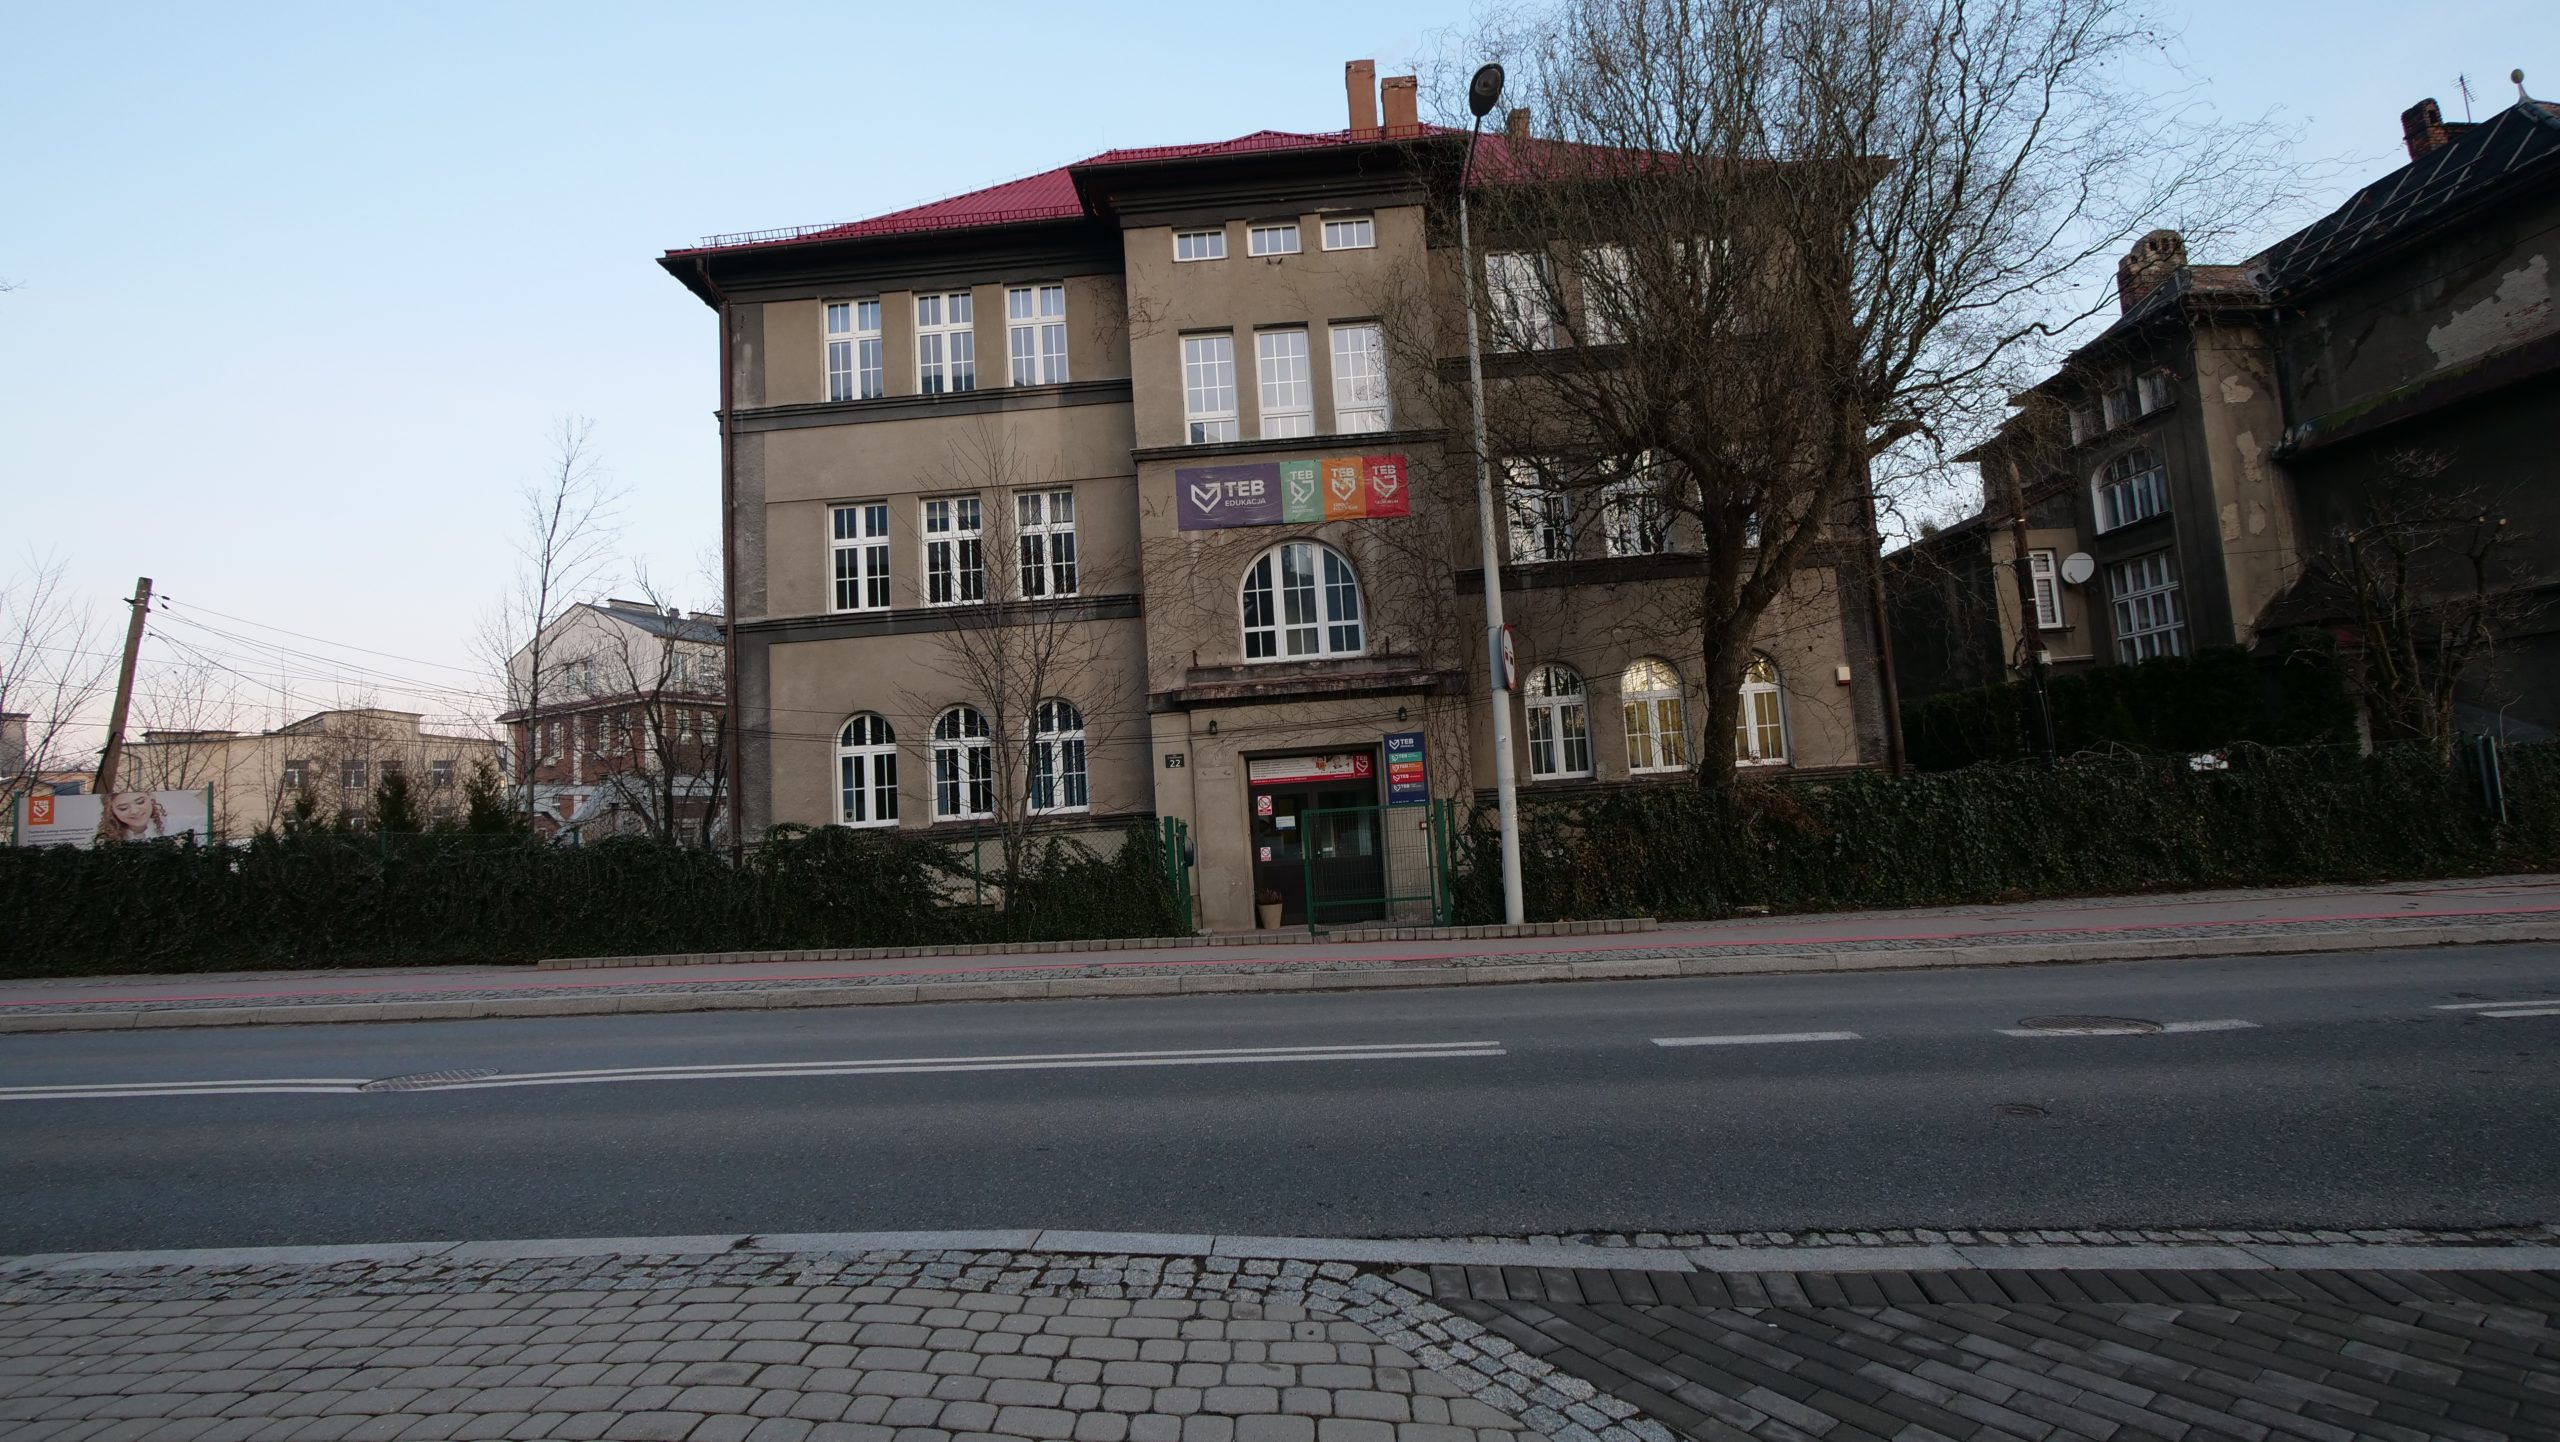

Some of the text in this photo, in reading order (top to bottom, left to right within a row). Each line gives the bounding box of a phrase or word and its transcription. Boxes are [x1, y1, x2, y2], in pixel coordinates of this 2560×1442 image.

[1331, 467, 1355, 478] TEB
[1372, 464, 1397, 475] TEB
[1290, 470, 1314, 481] TEB
[1224, 479, 1265, 497] TEB
[1224, 497, 1267, 507] EDUKACJA
[1169, 759, 1181, 768] 22
